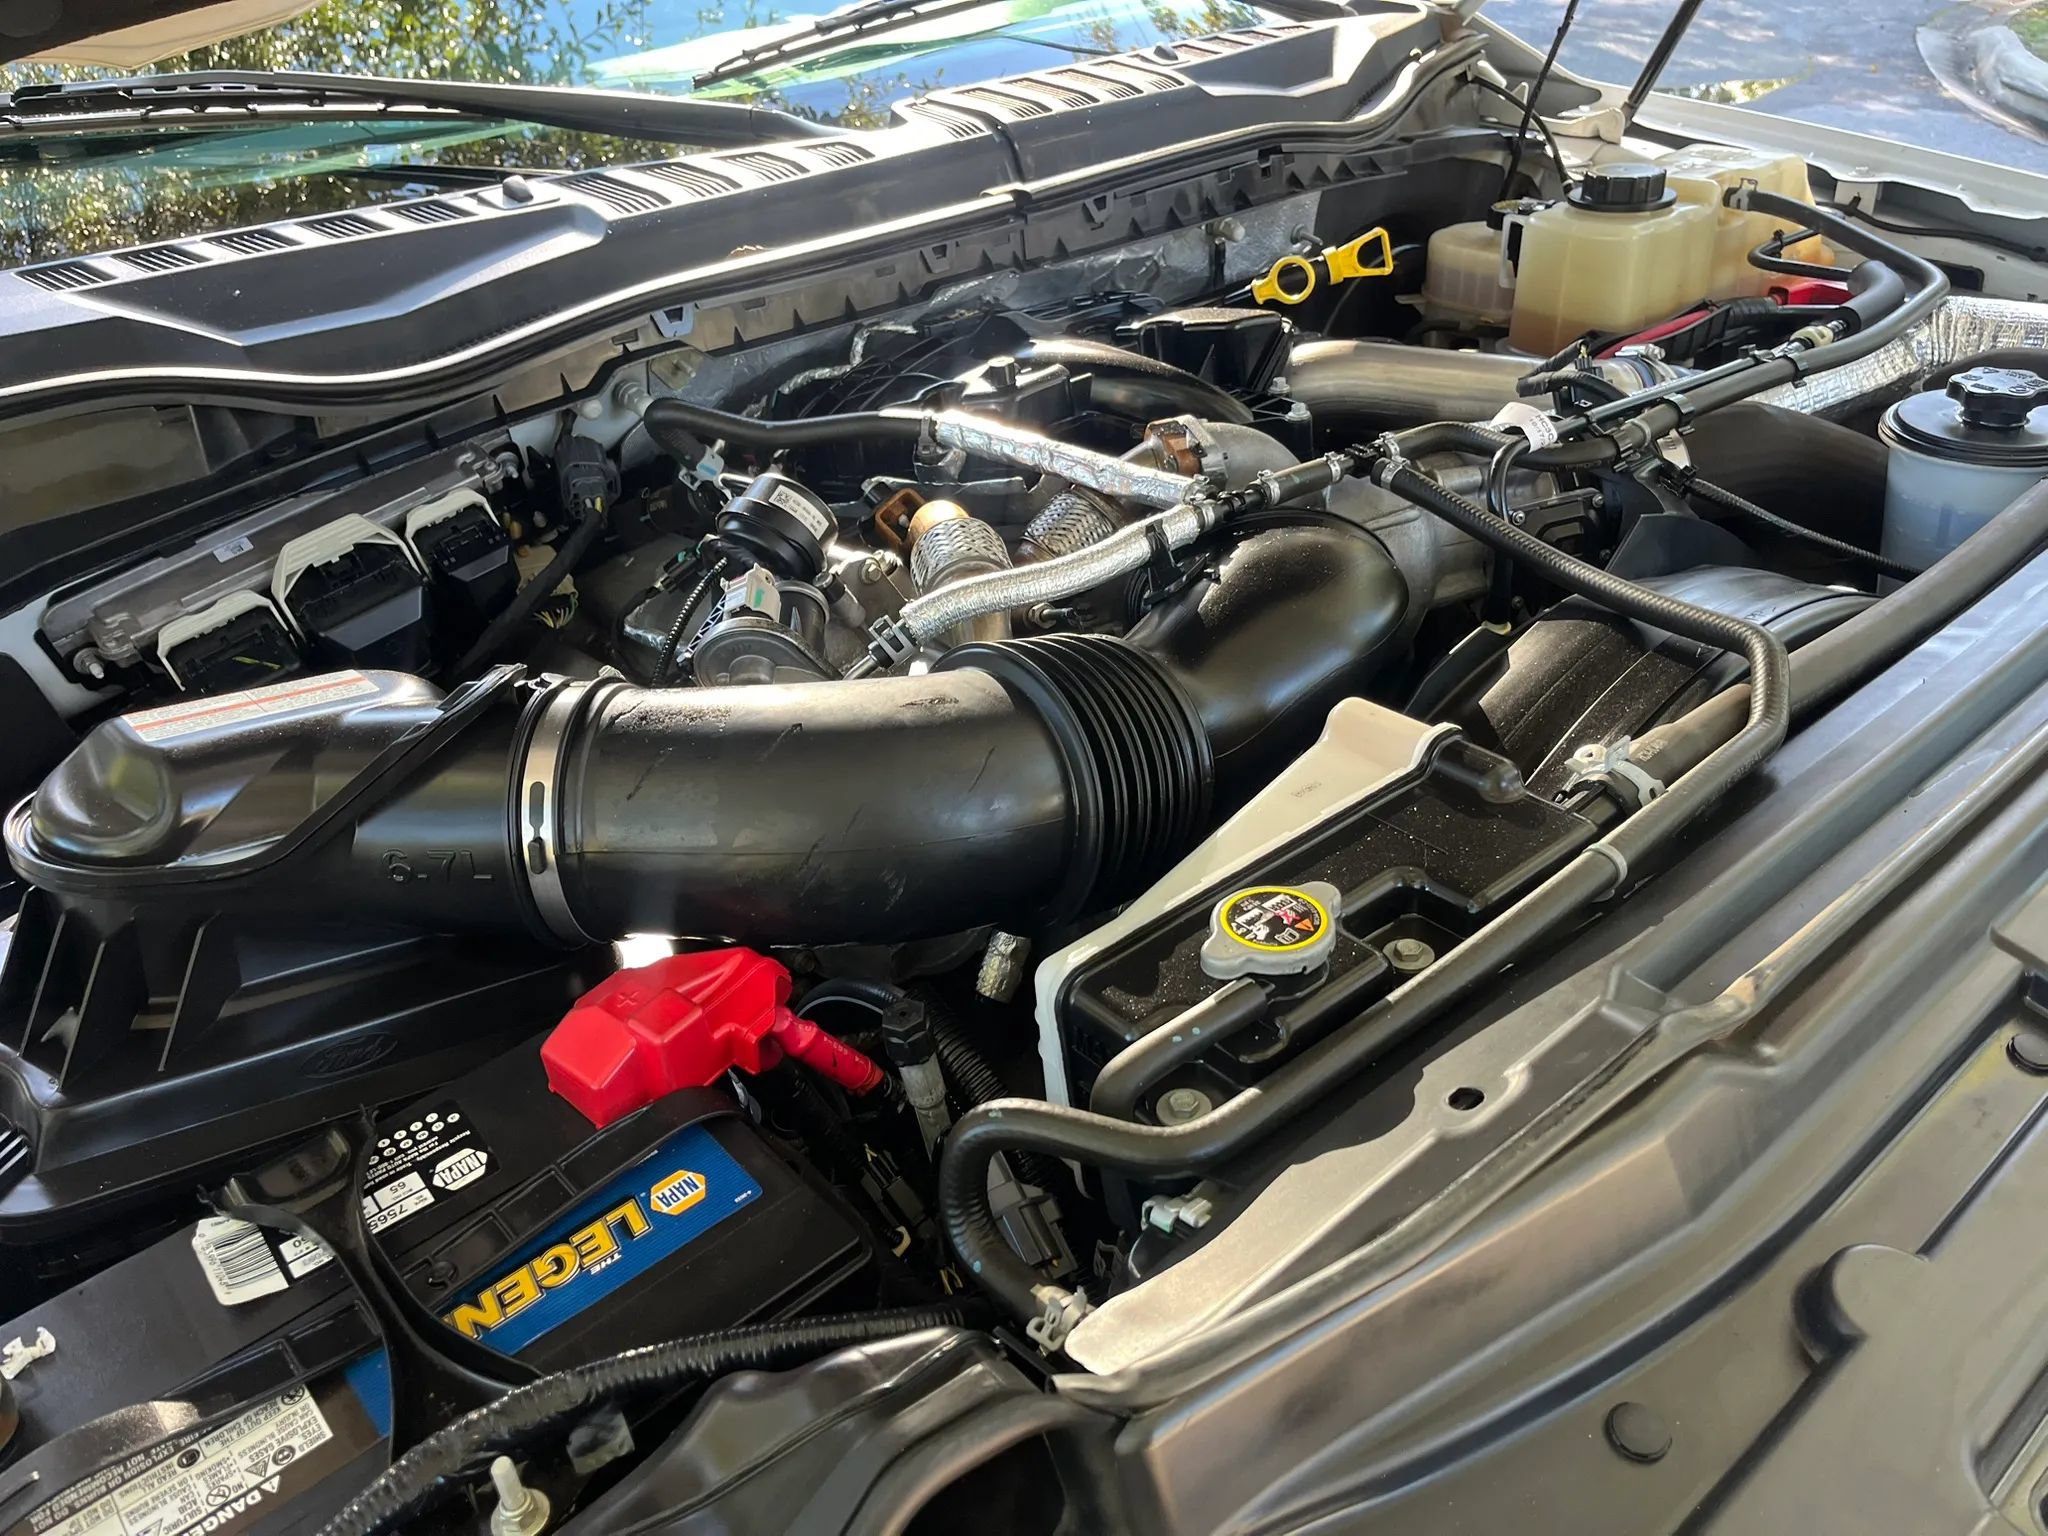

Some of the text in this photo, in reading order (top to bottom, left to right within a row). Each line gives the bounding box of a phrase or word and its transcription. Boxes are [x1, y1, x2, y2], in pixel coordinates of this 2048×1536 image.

[437, 1152, 481, 1186] NAPA
[389, 1180, 406, 1194] 65
[654, 1173, 699, 1210] NAPA
[436, 1197, 656, 1348] LEGEN
[587, 1251, 622, 1275] THE
[241, 1414, 254, 1425] OF
[253, 1399, 278, 1418] REACH
[218, 1405, 282, 1448] KEEP OUT OF THE
[236, 1408, 314, 1459] CAN CAUSE BLINDNESS
[247, 1415, 319, 1463] EXPLOSIVE GASES
[296, 1430, 327, 1452] SHIELD
[121, 1444, 175, 1480] EXPLOSION
[28, 1451, 147, 1525] NOT RECOMMENDED FOR
[105, 1475, 122, 1489] OR
[139, 1468, 178, 1494] READ ALL
[150, 1483, 177, 1503] SEVERE
[176, 1476, 189, 1488] OR
[229, 1480, 244, 1494] NO
[127, 1483, 192, 1526] CAUSE BLINDNESS
[176, 1497, 198, 1514] ACID
[178, 1490, 196, 1504] CAN
[160, 1505, 203, 1535] SULFURIC
[170, 1487, 263, 1536] DANGE
[30, 1515, 54, 1534] NOT
